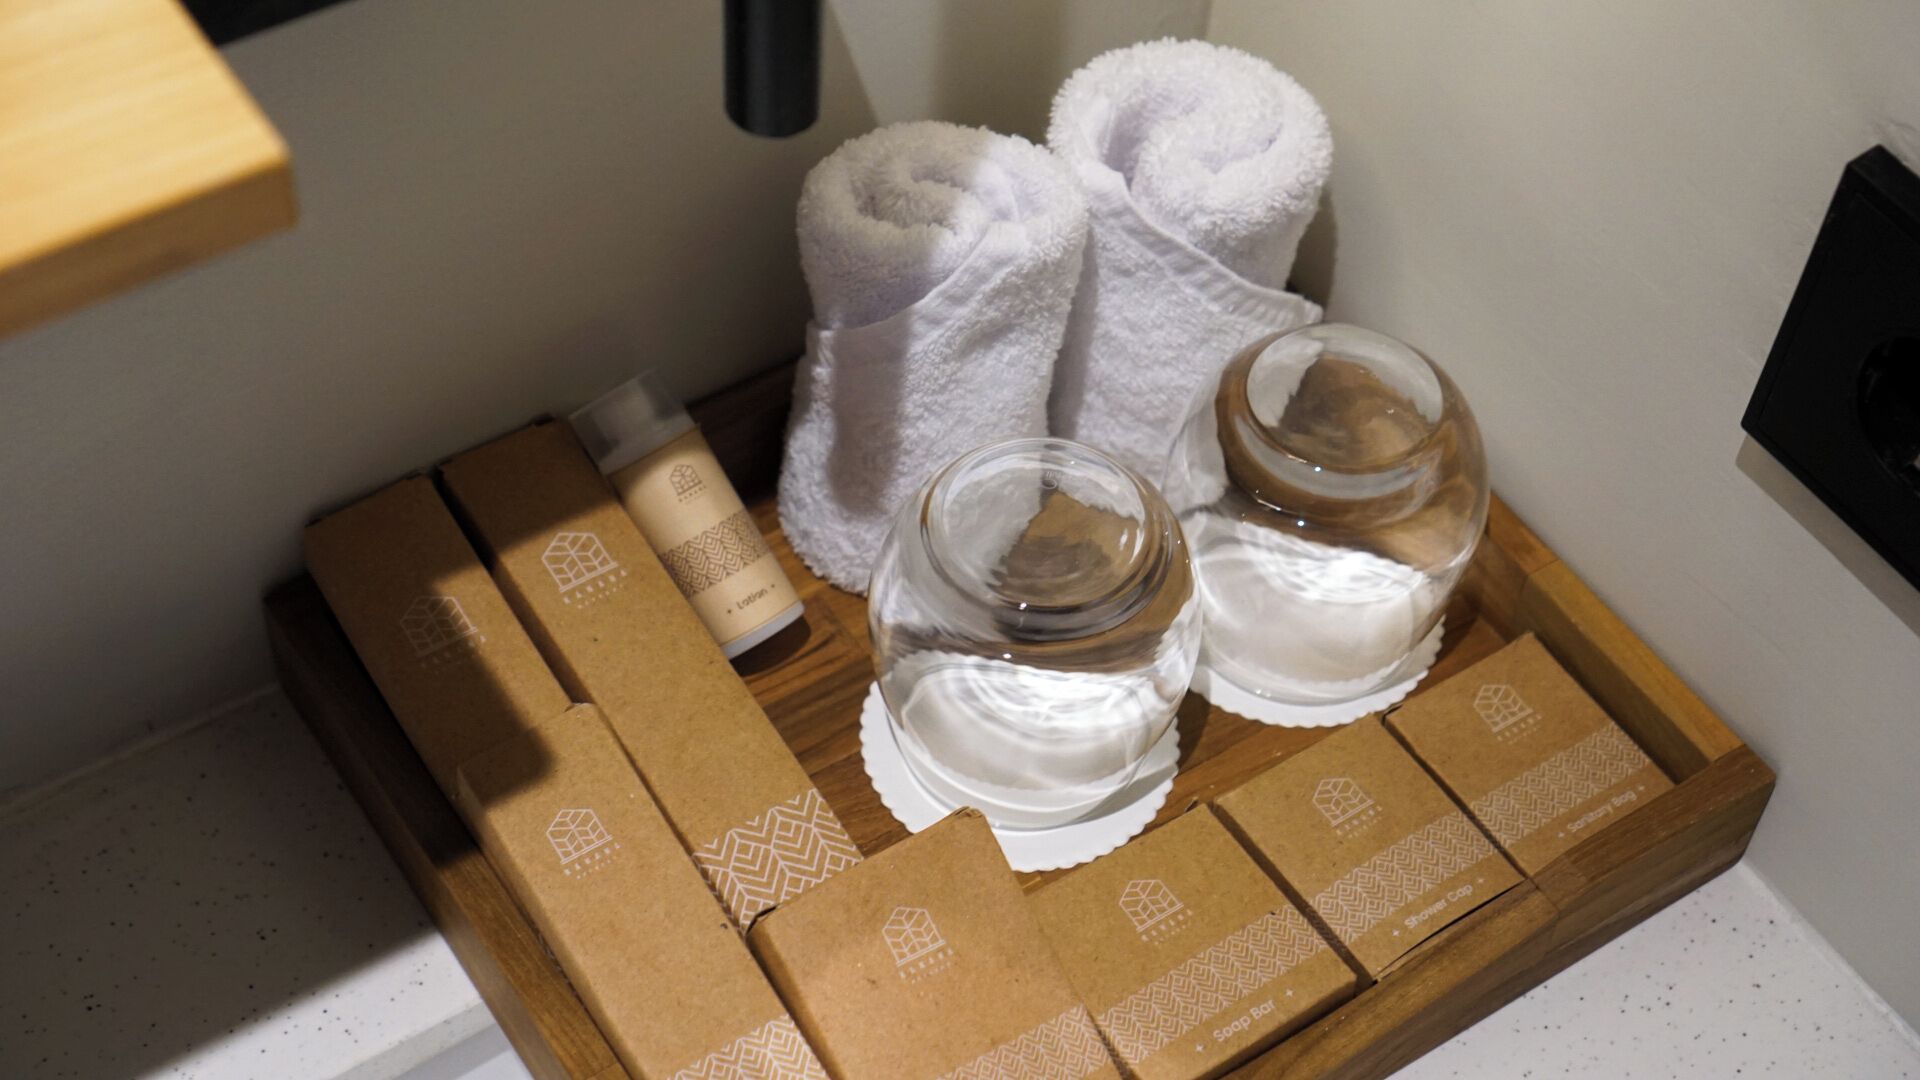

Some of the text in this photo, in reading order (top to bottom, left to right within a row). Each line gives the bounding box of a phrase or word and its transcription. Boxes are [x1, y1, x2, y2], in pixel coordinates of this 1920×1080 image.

[736, 588, 768, 610] Lotion
[1611, 790, 1637, 807] Bag
[1404, 884, 1473, 929] Shower Cap
[1213, 999, 1276, 1042] Soap Bar
